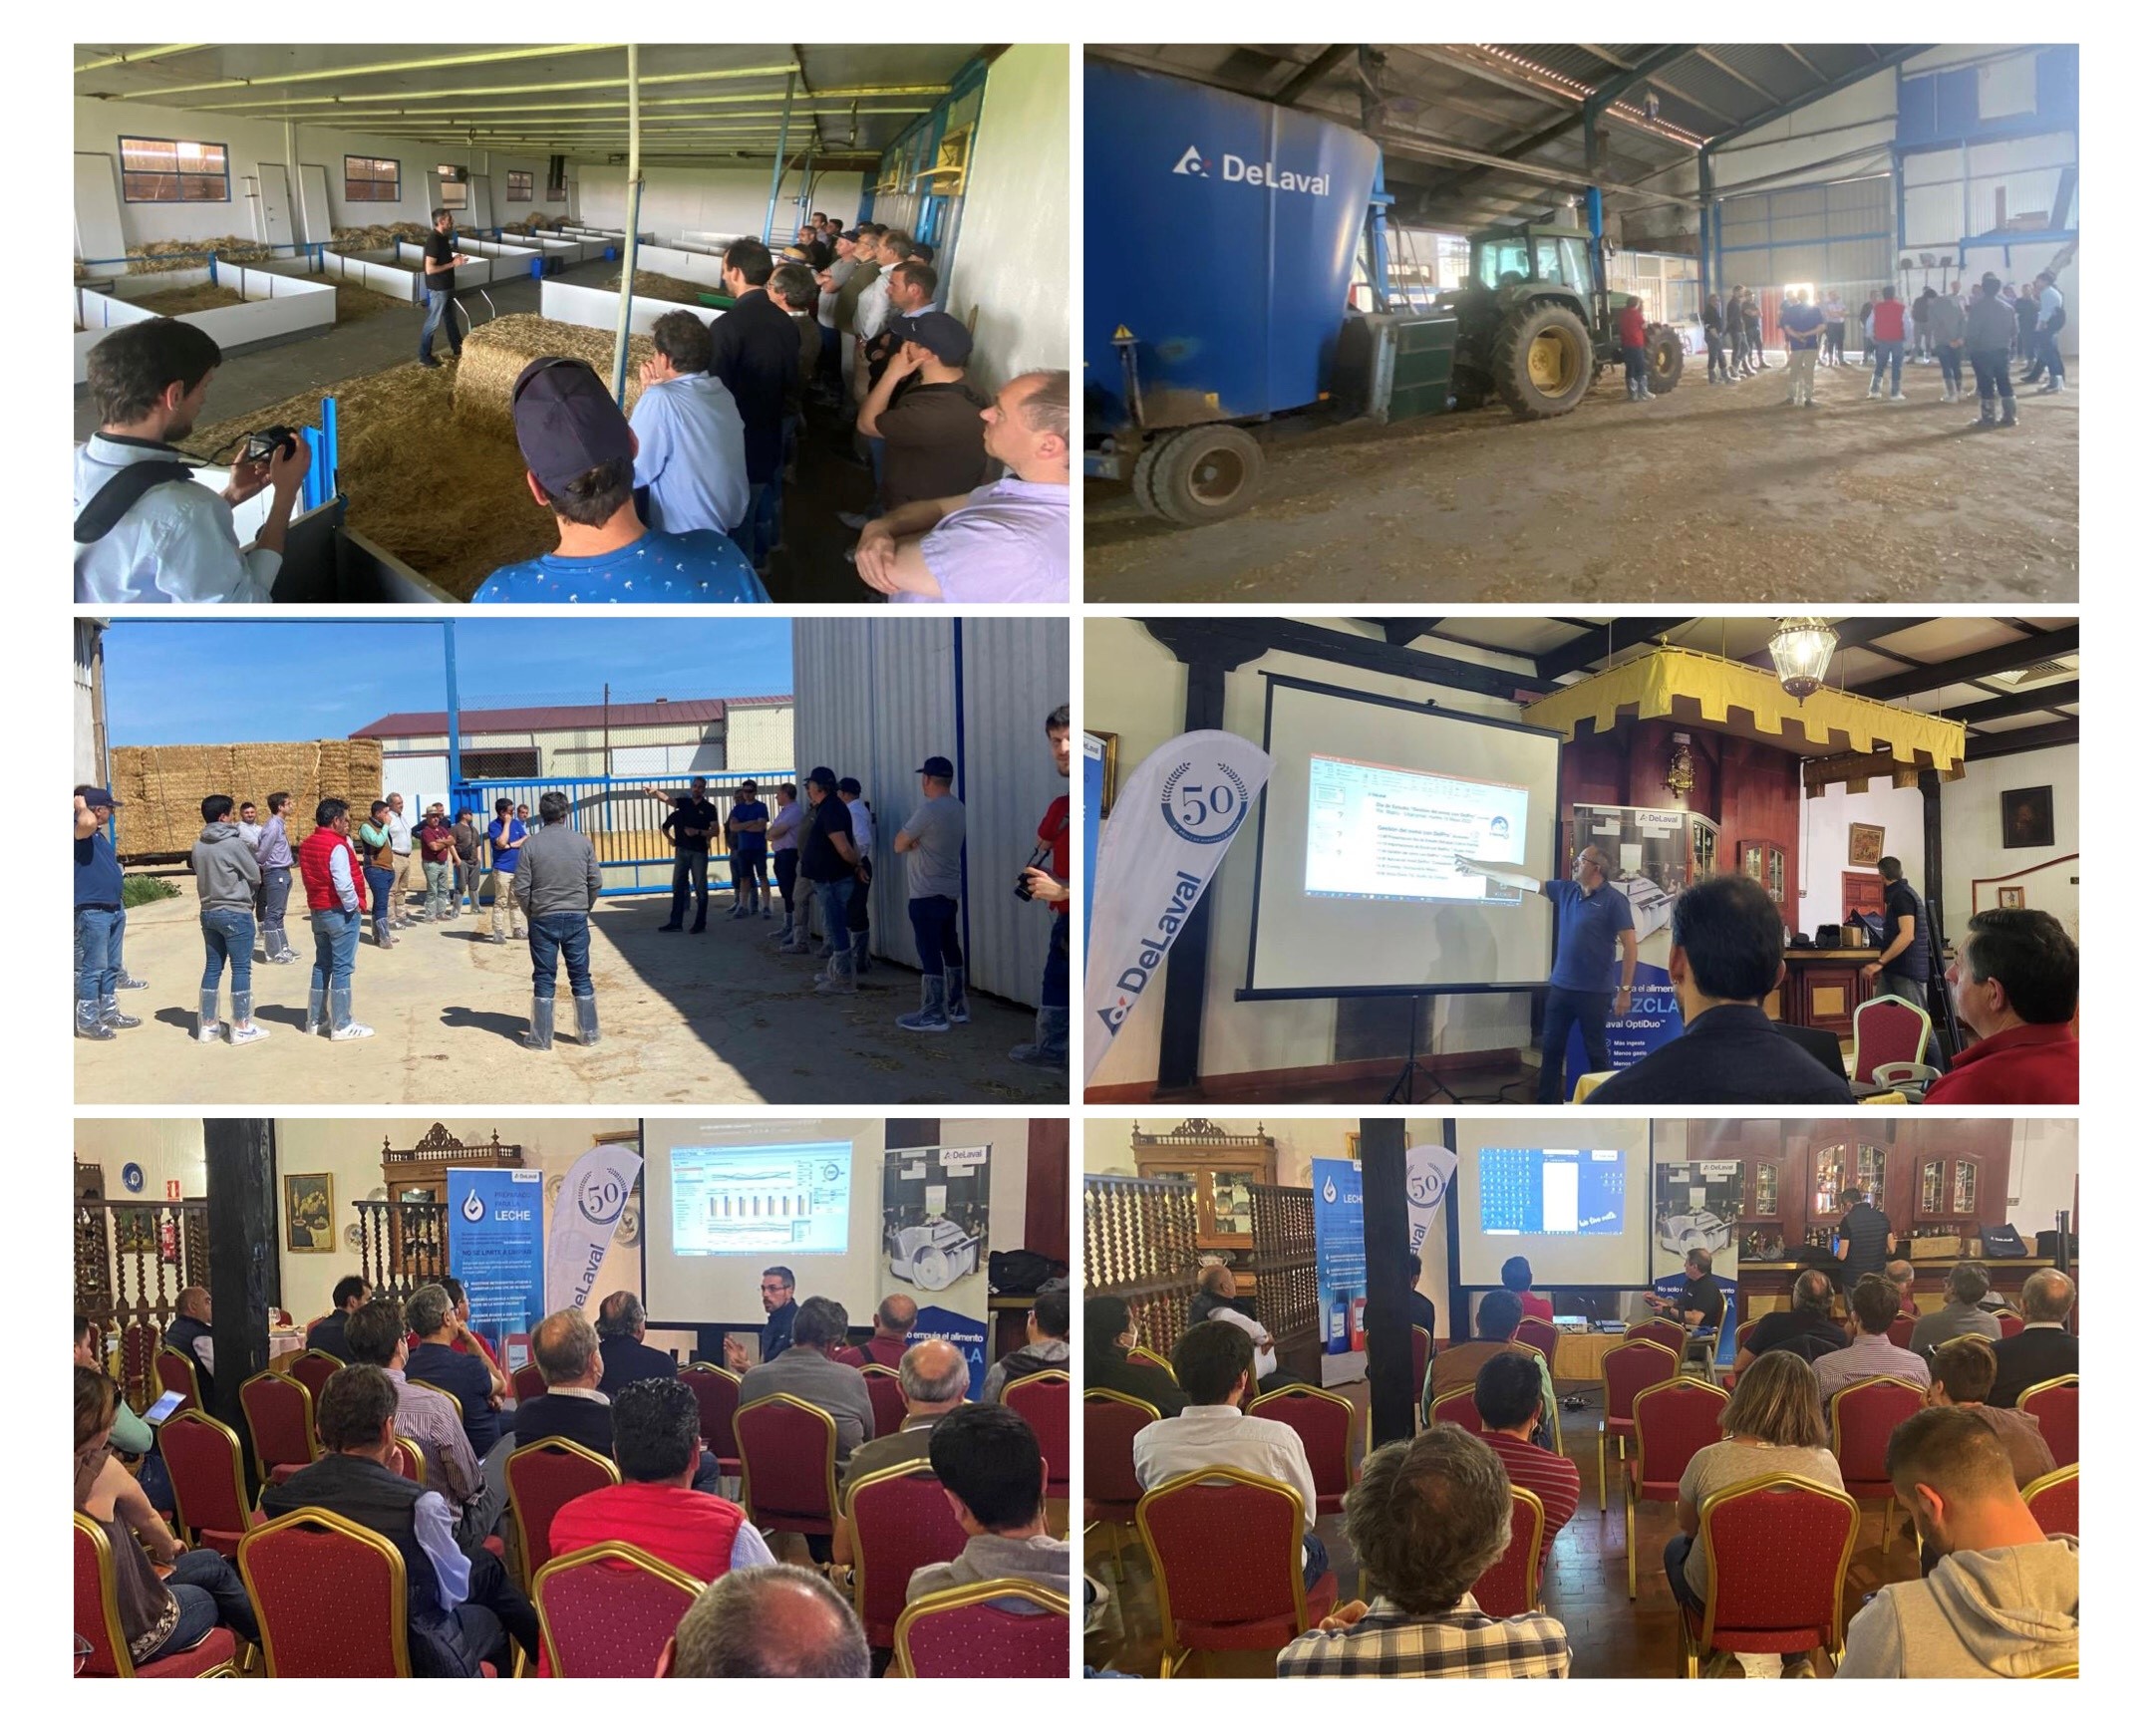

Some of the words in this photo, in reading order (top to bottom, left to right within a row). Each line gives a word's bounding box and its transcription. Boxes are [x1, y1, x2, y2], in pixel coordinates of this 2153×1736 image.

[1222, 152, 1330, 196] DeLaval
[1181, 784, 1234, 826] 50
[1648, 814, 1679, 823] DeLaval
[1115, 870, 1202, 995] DeLaval
[1638, 984, 1645, 993] el
[1629, 998, 1680, 1013] ZCLA
[1605, 1019, 1624, 1028] aval
[1626, 1039, 1646, 1048] ingesta
[953, 1150, 983, 1159] DeLaval
[1410, 1175, 1438, 1200] 50
[587, 1182, 619, 1214] 50
[494, 1210, 531, 1222] LECHE
[568, 1243, 605, 1312] eLaval
[942, 1331, 949, 1340] el
[950, 1331, 984, 1343] alimento
